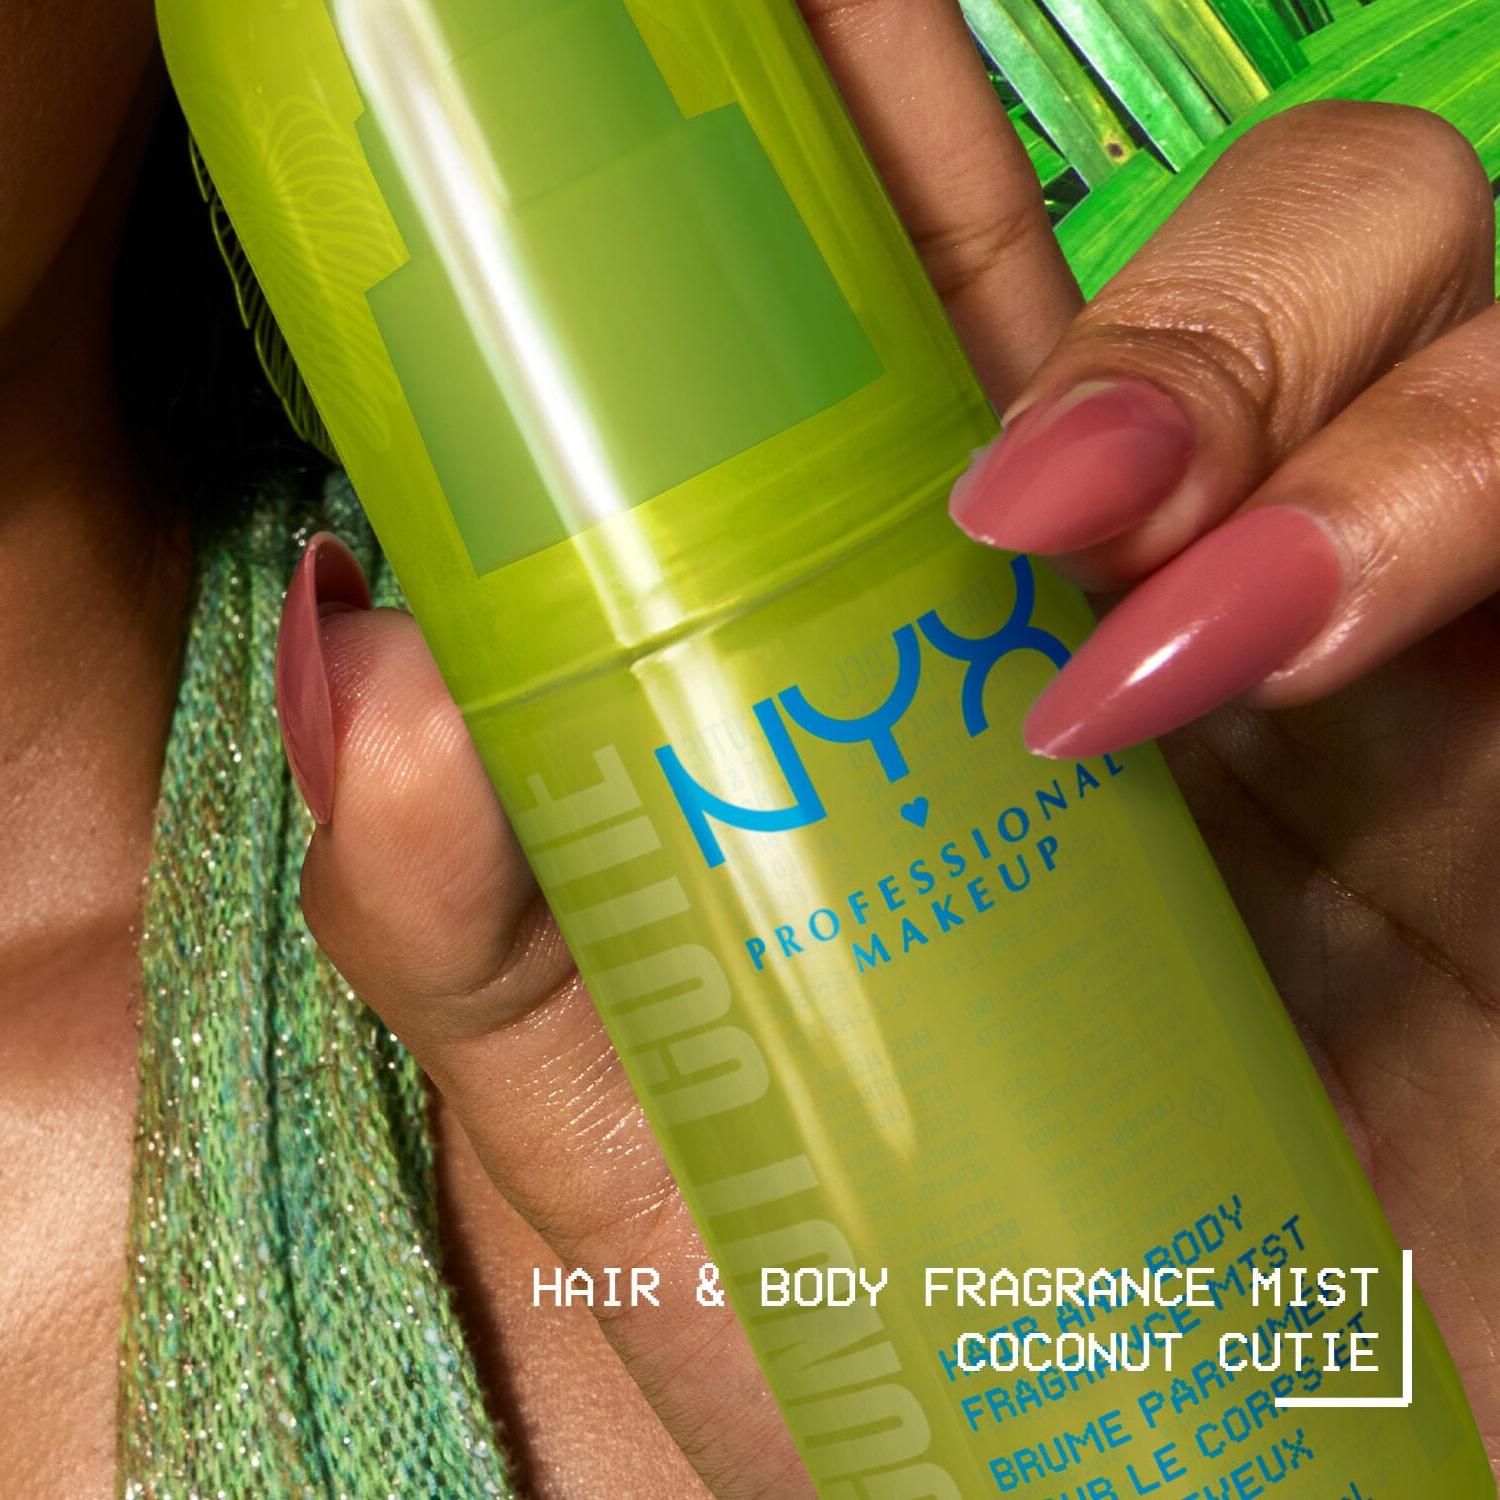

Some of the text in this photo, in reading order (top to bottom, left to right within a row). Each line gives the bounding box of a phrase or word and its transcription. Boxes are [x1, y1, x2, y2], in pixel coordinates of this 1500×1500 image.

[655, 554, 1072, 868] NYX
[745, 752, 1125, 971] PROFESSIONAL
[850, 835, 1059, 974] MAKEUP
[938, 1315, 1045, 1382] HAIR
[1056, 1269, 1138, 1336] AND
[1144, 1194, 1244, 1285] BODY
[961, 1214, 1306, 1431] FRAGRANCE MIST
[988, 1409, 1132, 1492] BRUME
[1126, 1442, 1188, 1496] LE
[1194, 1355, 1323, 1459] CORPS
